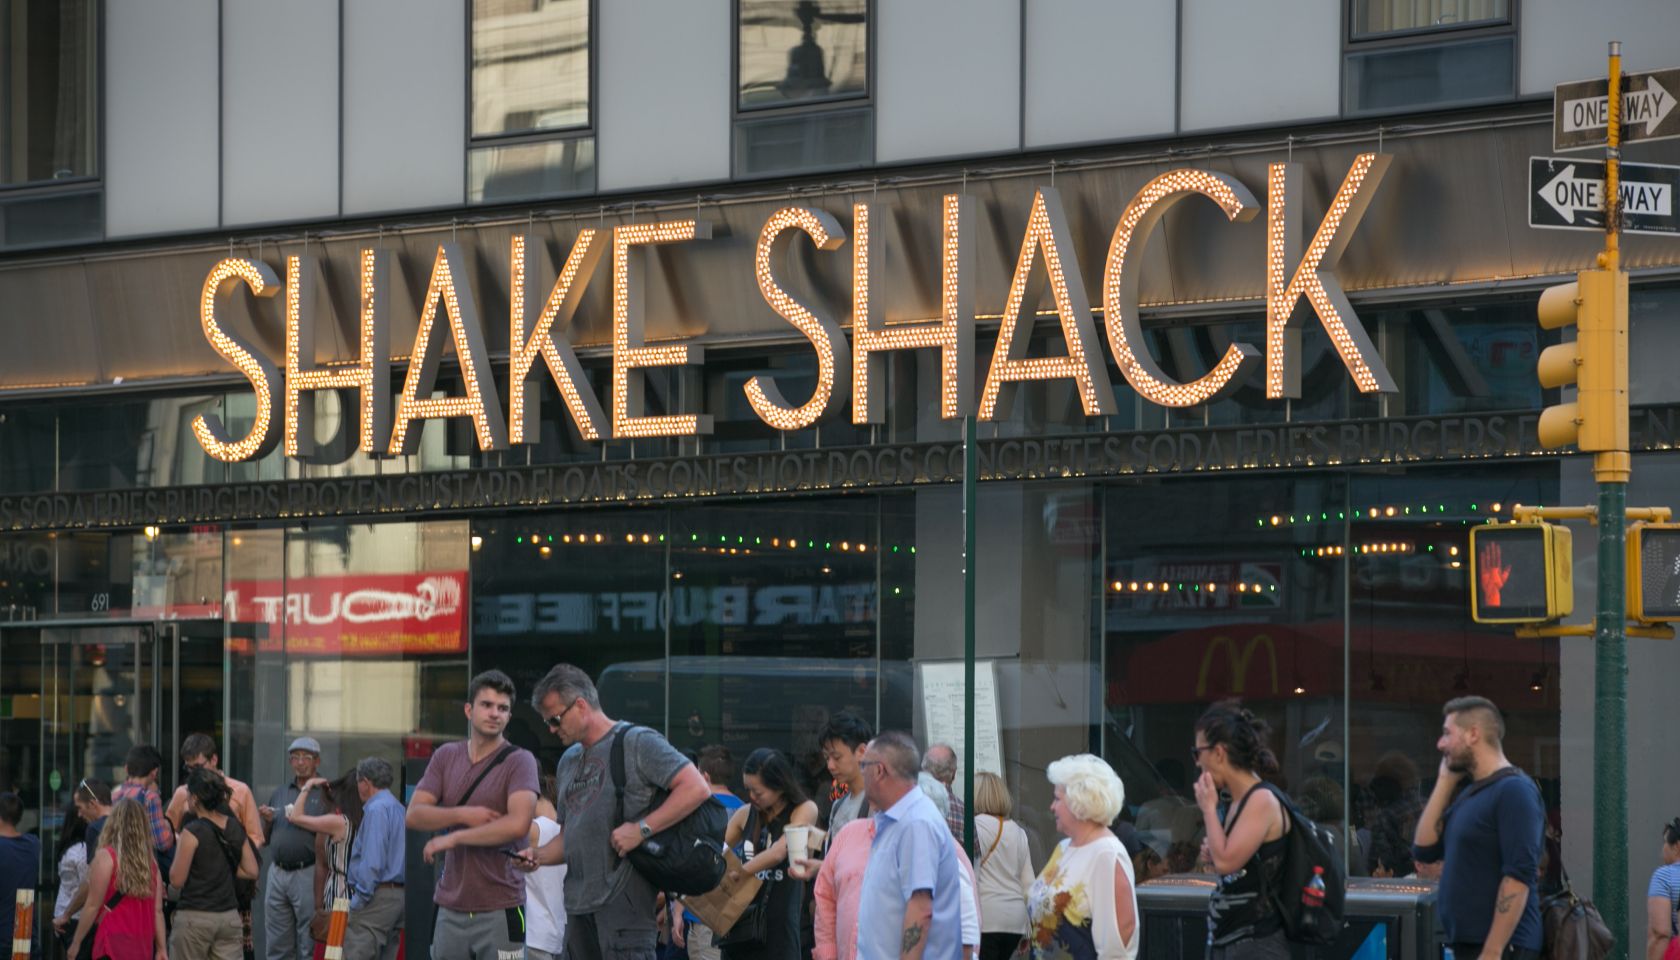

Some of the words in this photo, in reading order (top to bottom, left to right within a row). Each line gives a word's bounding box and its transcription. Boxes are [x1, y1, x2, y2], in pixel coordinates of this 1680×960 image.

[1573, 99, 1608, 128] ONE
[1626, 92, 1664, 121] WAY
[1555, 181, 1598, 208] ONE
[1620, 184, 1662, 211] WAY
[191, 220, 708, 463] SHAKE
[744, 152, 1396, 430] SHACK
[20, 495, 87, 528] SODA
[93, 489, 159, 526] FRIES
[166, 484, 280, 523] BURGERS
[287, 478, 390, 515] FROZEN
[398, 470, 525, 511] CUSTARD
[532, 463, 638, 503] FLOATS
[646, 456, 748, 497] CONES
[757, 452, 822, 493] HOT
[829, 446, 914, 487] DOGS
[924, 436, 1120, 481] CONCRETES
[1131, 432, 1224, 475] SODA
[1236, 425, 1329, 470] FRIES
[1339, 415, 1507, 465] BURGERS
[91, 593, 109, 612] 691
